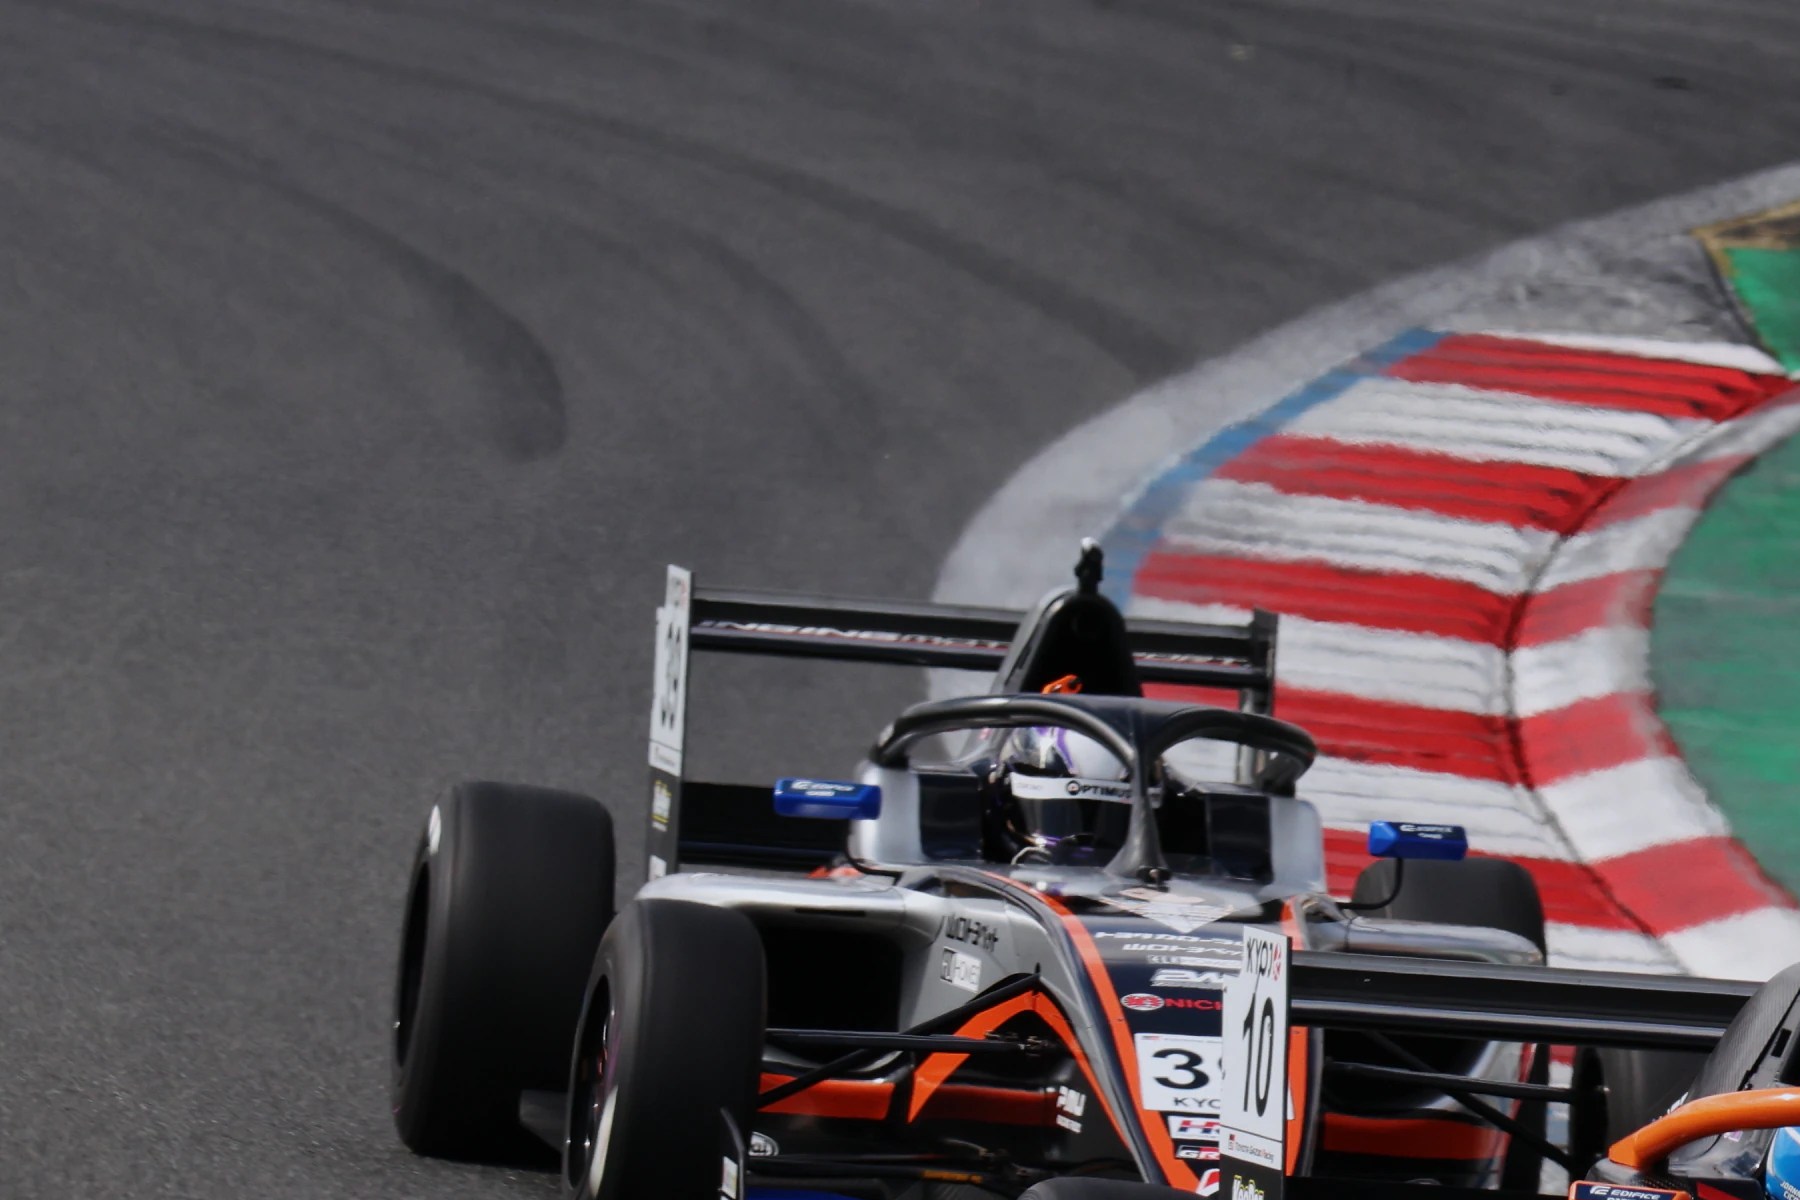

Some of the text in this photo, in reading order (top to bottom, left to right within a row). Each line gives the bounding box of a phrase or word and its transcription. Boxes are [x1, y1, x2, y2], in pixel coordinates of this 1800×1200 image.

[1152, 1048, 1223, 1090] 3
[1242, 992, 1274, 1117] 10
[1610, 1189, 1661, 1200] EDIFICE
